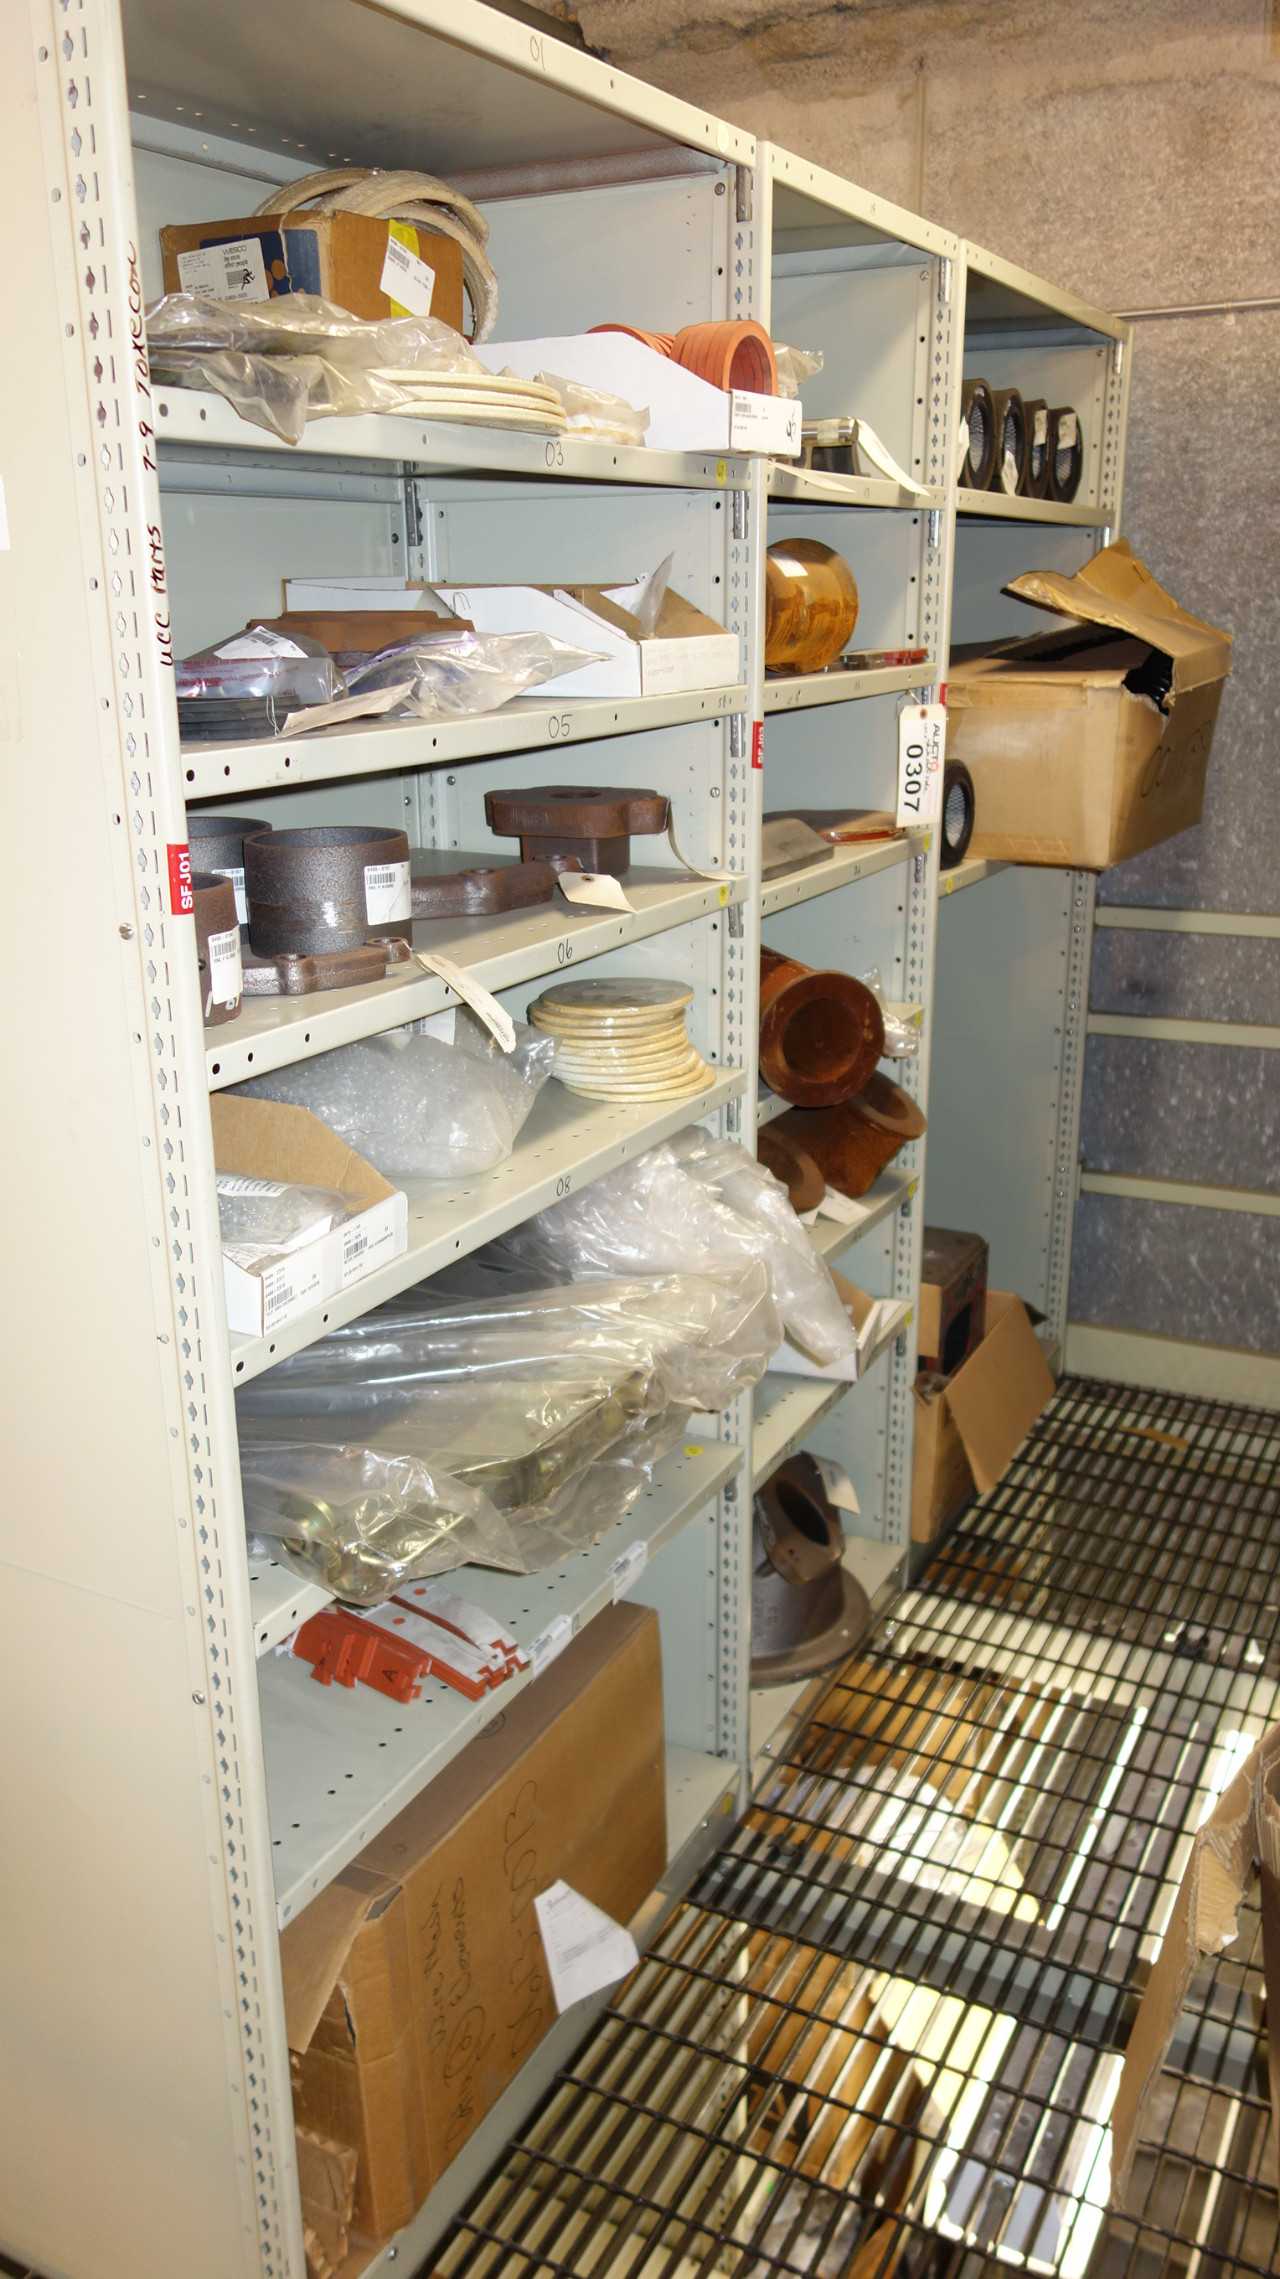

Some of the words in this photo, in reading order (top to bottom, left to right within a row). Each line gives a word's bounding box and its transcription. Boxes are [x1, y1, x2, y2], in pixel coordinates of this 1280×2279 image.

[530, 35, 546, 71] 01
[545, 440, 564, 467] 03
[548, 714, 573, 739] 05
[904, 744, 924, 813] 0307
[177, 852, 194, 910] SFJ01
[557, 938, 573, 964] 06
[556, 1175, 571, 1197] 08
